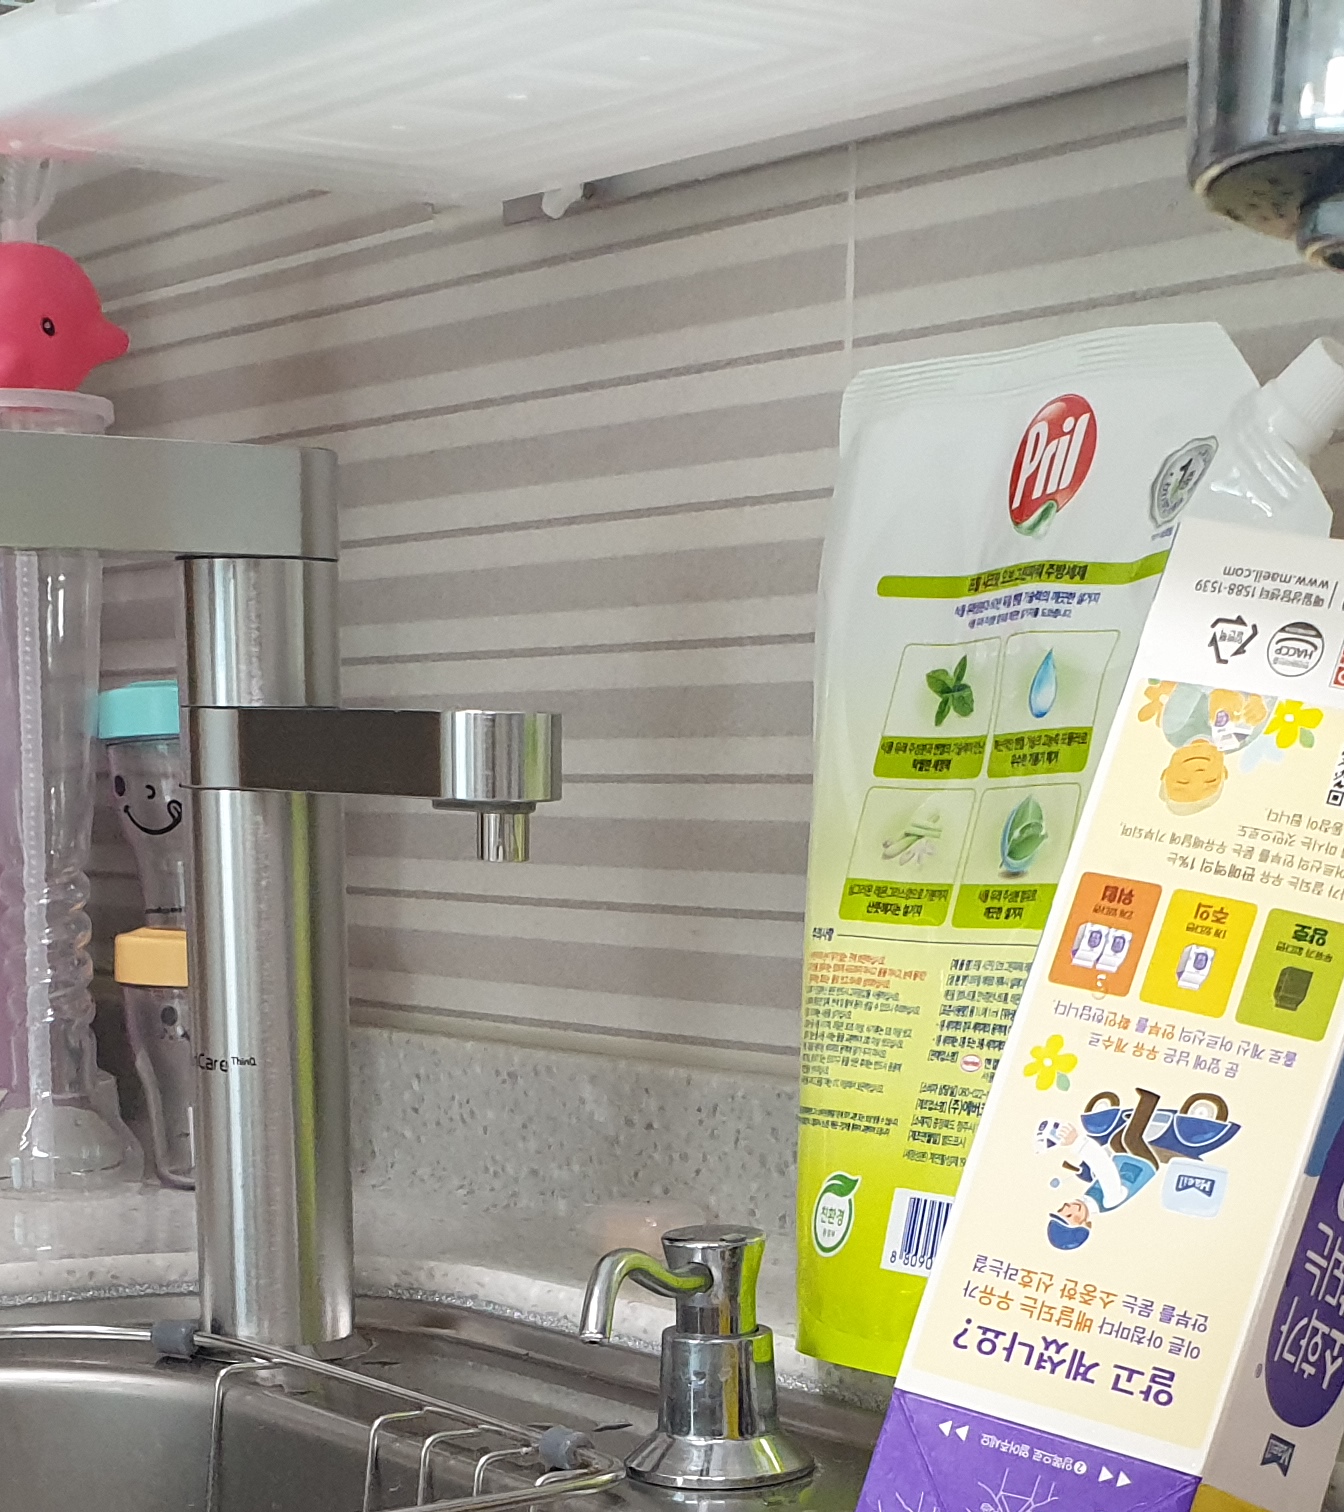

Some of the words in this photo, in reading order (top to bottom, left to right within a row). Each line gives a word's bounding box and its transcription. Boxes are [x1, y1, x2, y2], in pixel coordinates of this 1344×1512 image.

[1012, 412, 1091, 511] Pril
[1195, 579, 1256, 598] 1588-1539
[1223, 566, 1330, 591] www.maeil.com
[1260, 586, 1325, 608] 매일상담센터
[1275, 646, 1314, 661] HACCP
[1169, 832, 1228, 854] 우유배달에
[1237, 824, 1297, 849] 것만으로도
[1300, 836, 1338, 855] 마시는
[1166, 851, 1196, 872] 1%는
[1258, 848, 1295, 868] 안부를
[1199, 858, 1256, 883] 판매액의
[1259, 870, 1283, 888] 우유
[1101, 885, 1135, 906] 위험
[1287, 876, 1324, 897] 잘되는
[1193, 901, 1230, 924] 주의
[1290, 923, 1329, 947] 양호
[1135, 1016, 1176, 1041] 안부를
[1177, 1026, 1233, 1052] 어르신의
[231, 1056, 258, 1066] ThinQ
[1132, 1041, 1160, 1060] 우유
[1162, 1047, 1191, 1067] 남은
[1235, 1040, 1266, 1059] 계신
[1268, 1048, 1298, 1069] 홀로
[1193, 1054, 1221, 1075] 앞에
[1224, 1061, 1239, 1079] 문
[972, 1254, 1055, 1295] 신호라는걸
[962, 1280, 1015, 1312] 우유가
[1059, 1278, 1118, 1311] 소중한
[1122, 1294, 1155, 1318] 묻는
[1018, 1295, 1094, 1334] 배달되는
[1158, 1304, 1209, 1334] 안부를
[1097, 1316, 1164, 1350] 아침마다
[952, 1317, 1100, 1385] 계셨나요?
[1168, 1337, 1202, 1360] 이른
[1111, 1364, 1177, 1407] 알고
